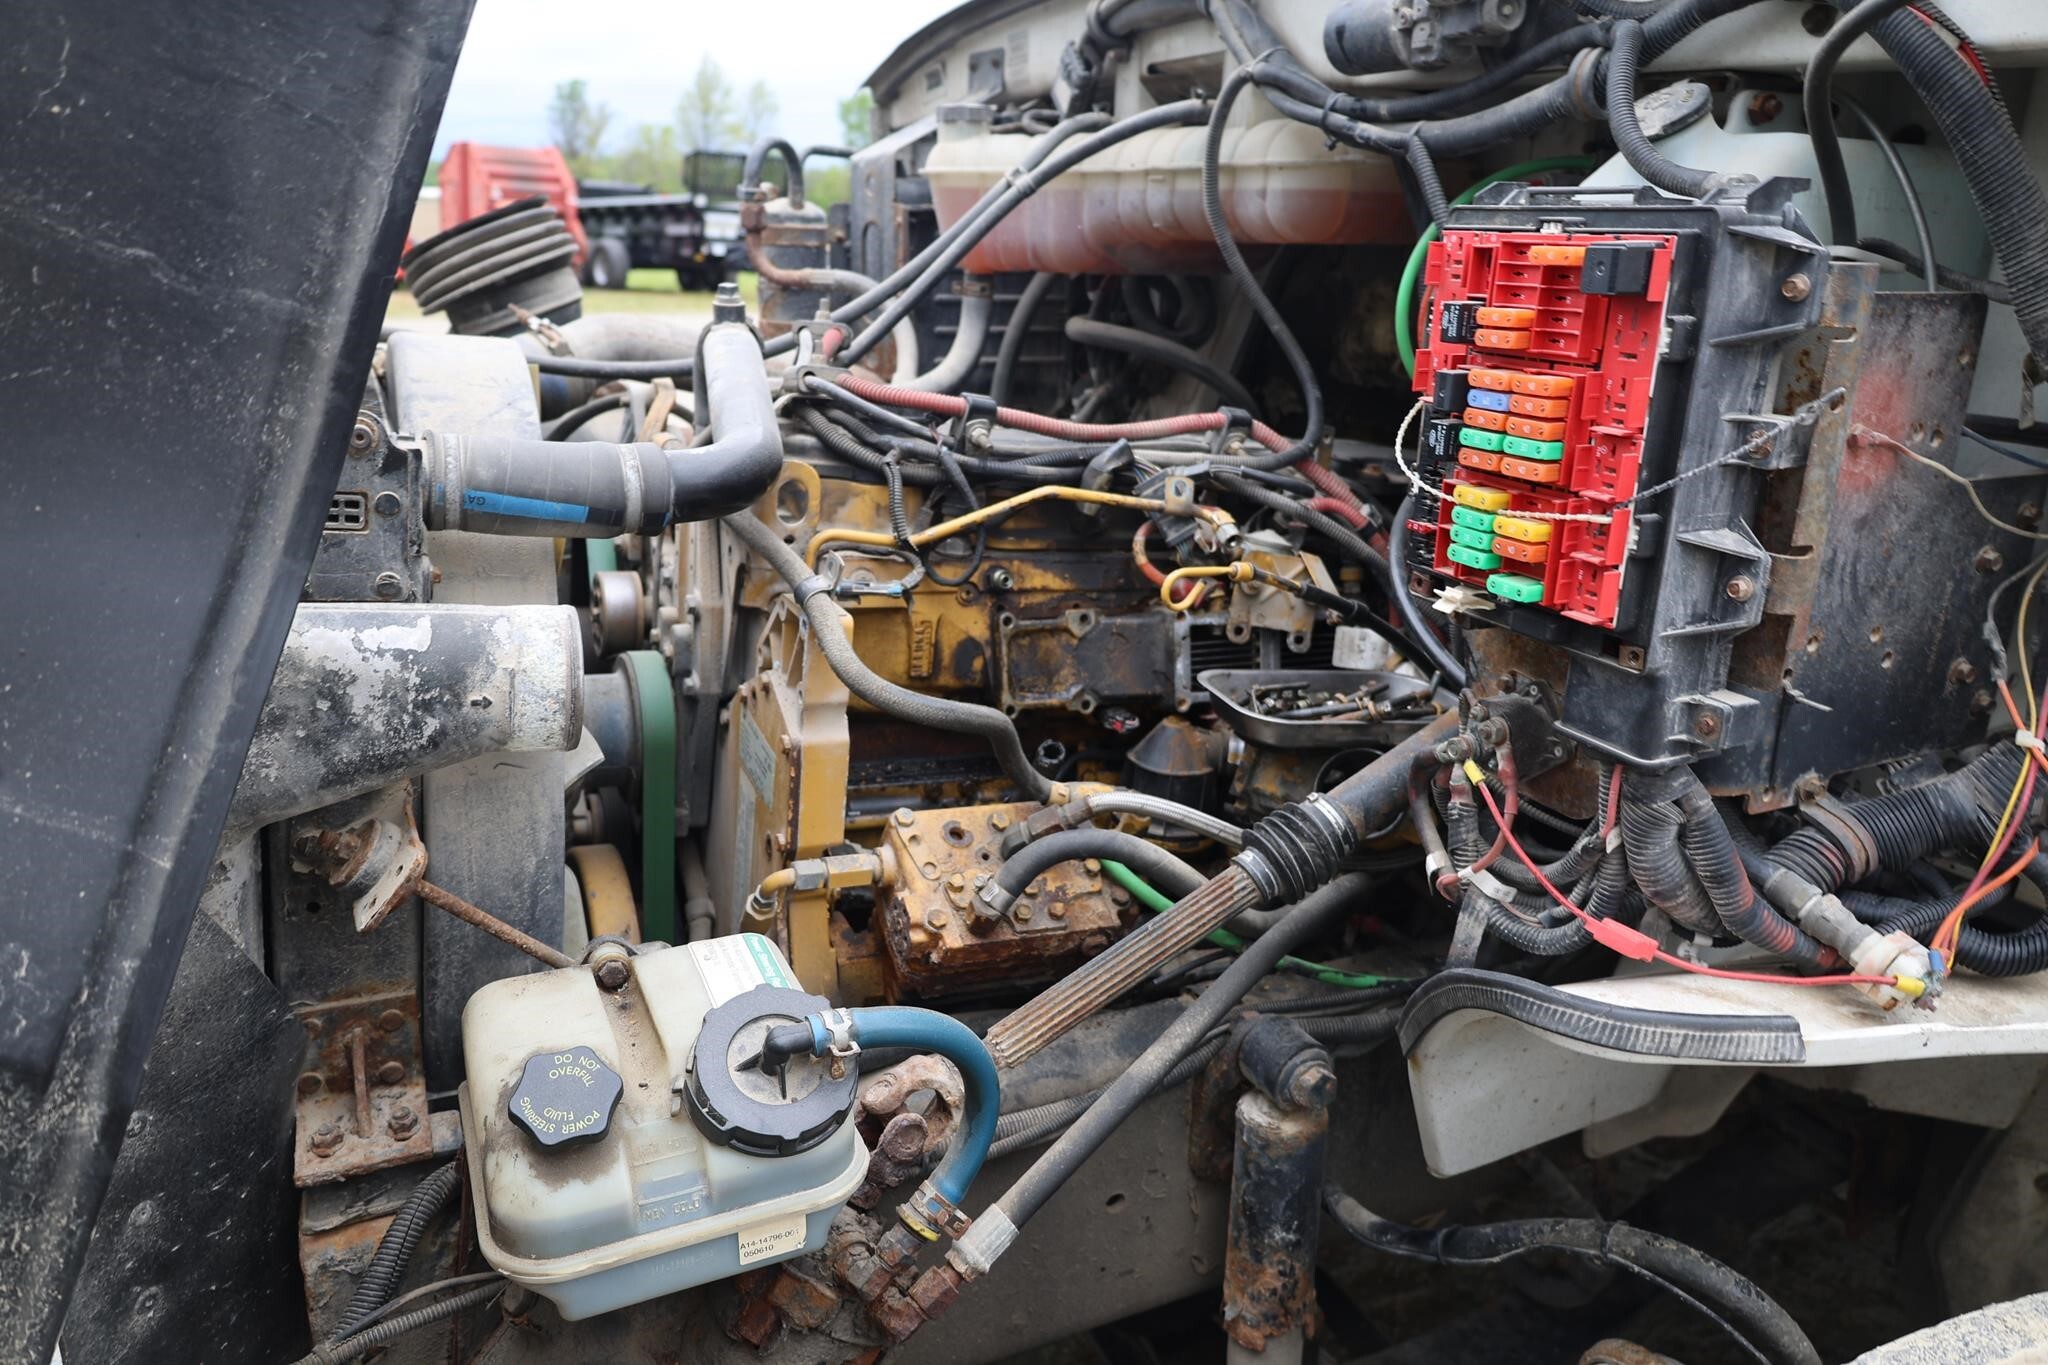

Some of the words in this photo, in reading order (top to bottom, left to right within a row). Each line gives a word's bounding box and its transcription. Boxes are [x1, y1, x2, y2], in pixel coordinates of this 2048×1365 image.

[554, 1053, 573, 1065] DO
[578, 1055, 601, 1072] NOT
[548, 1065, 596, 1088] OVERFILL
[520, 1096, 556, 1133] STEERING
[543, 1106, 575, 1121] FLUID
[561, 1110, 601, 1135] POWER
[743, 1244, 774, 1258] 050610
